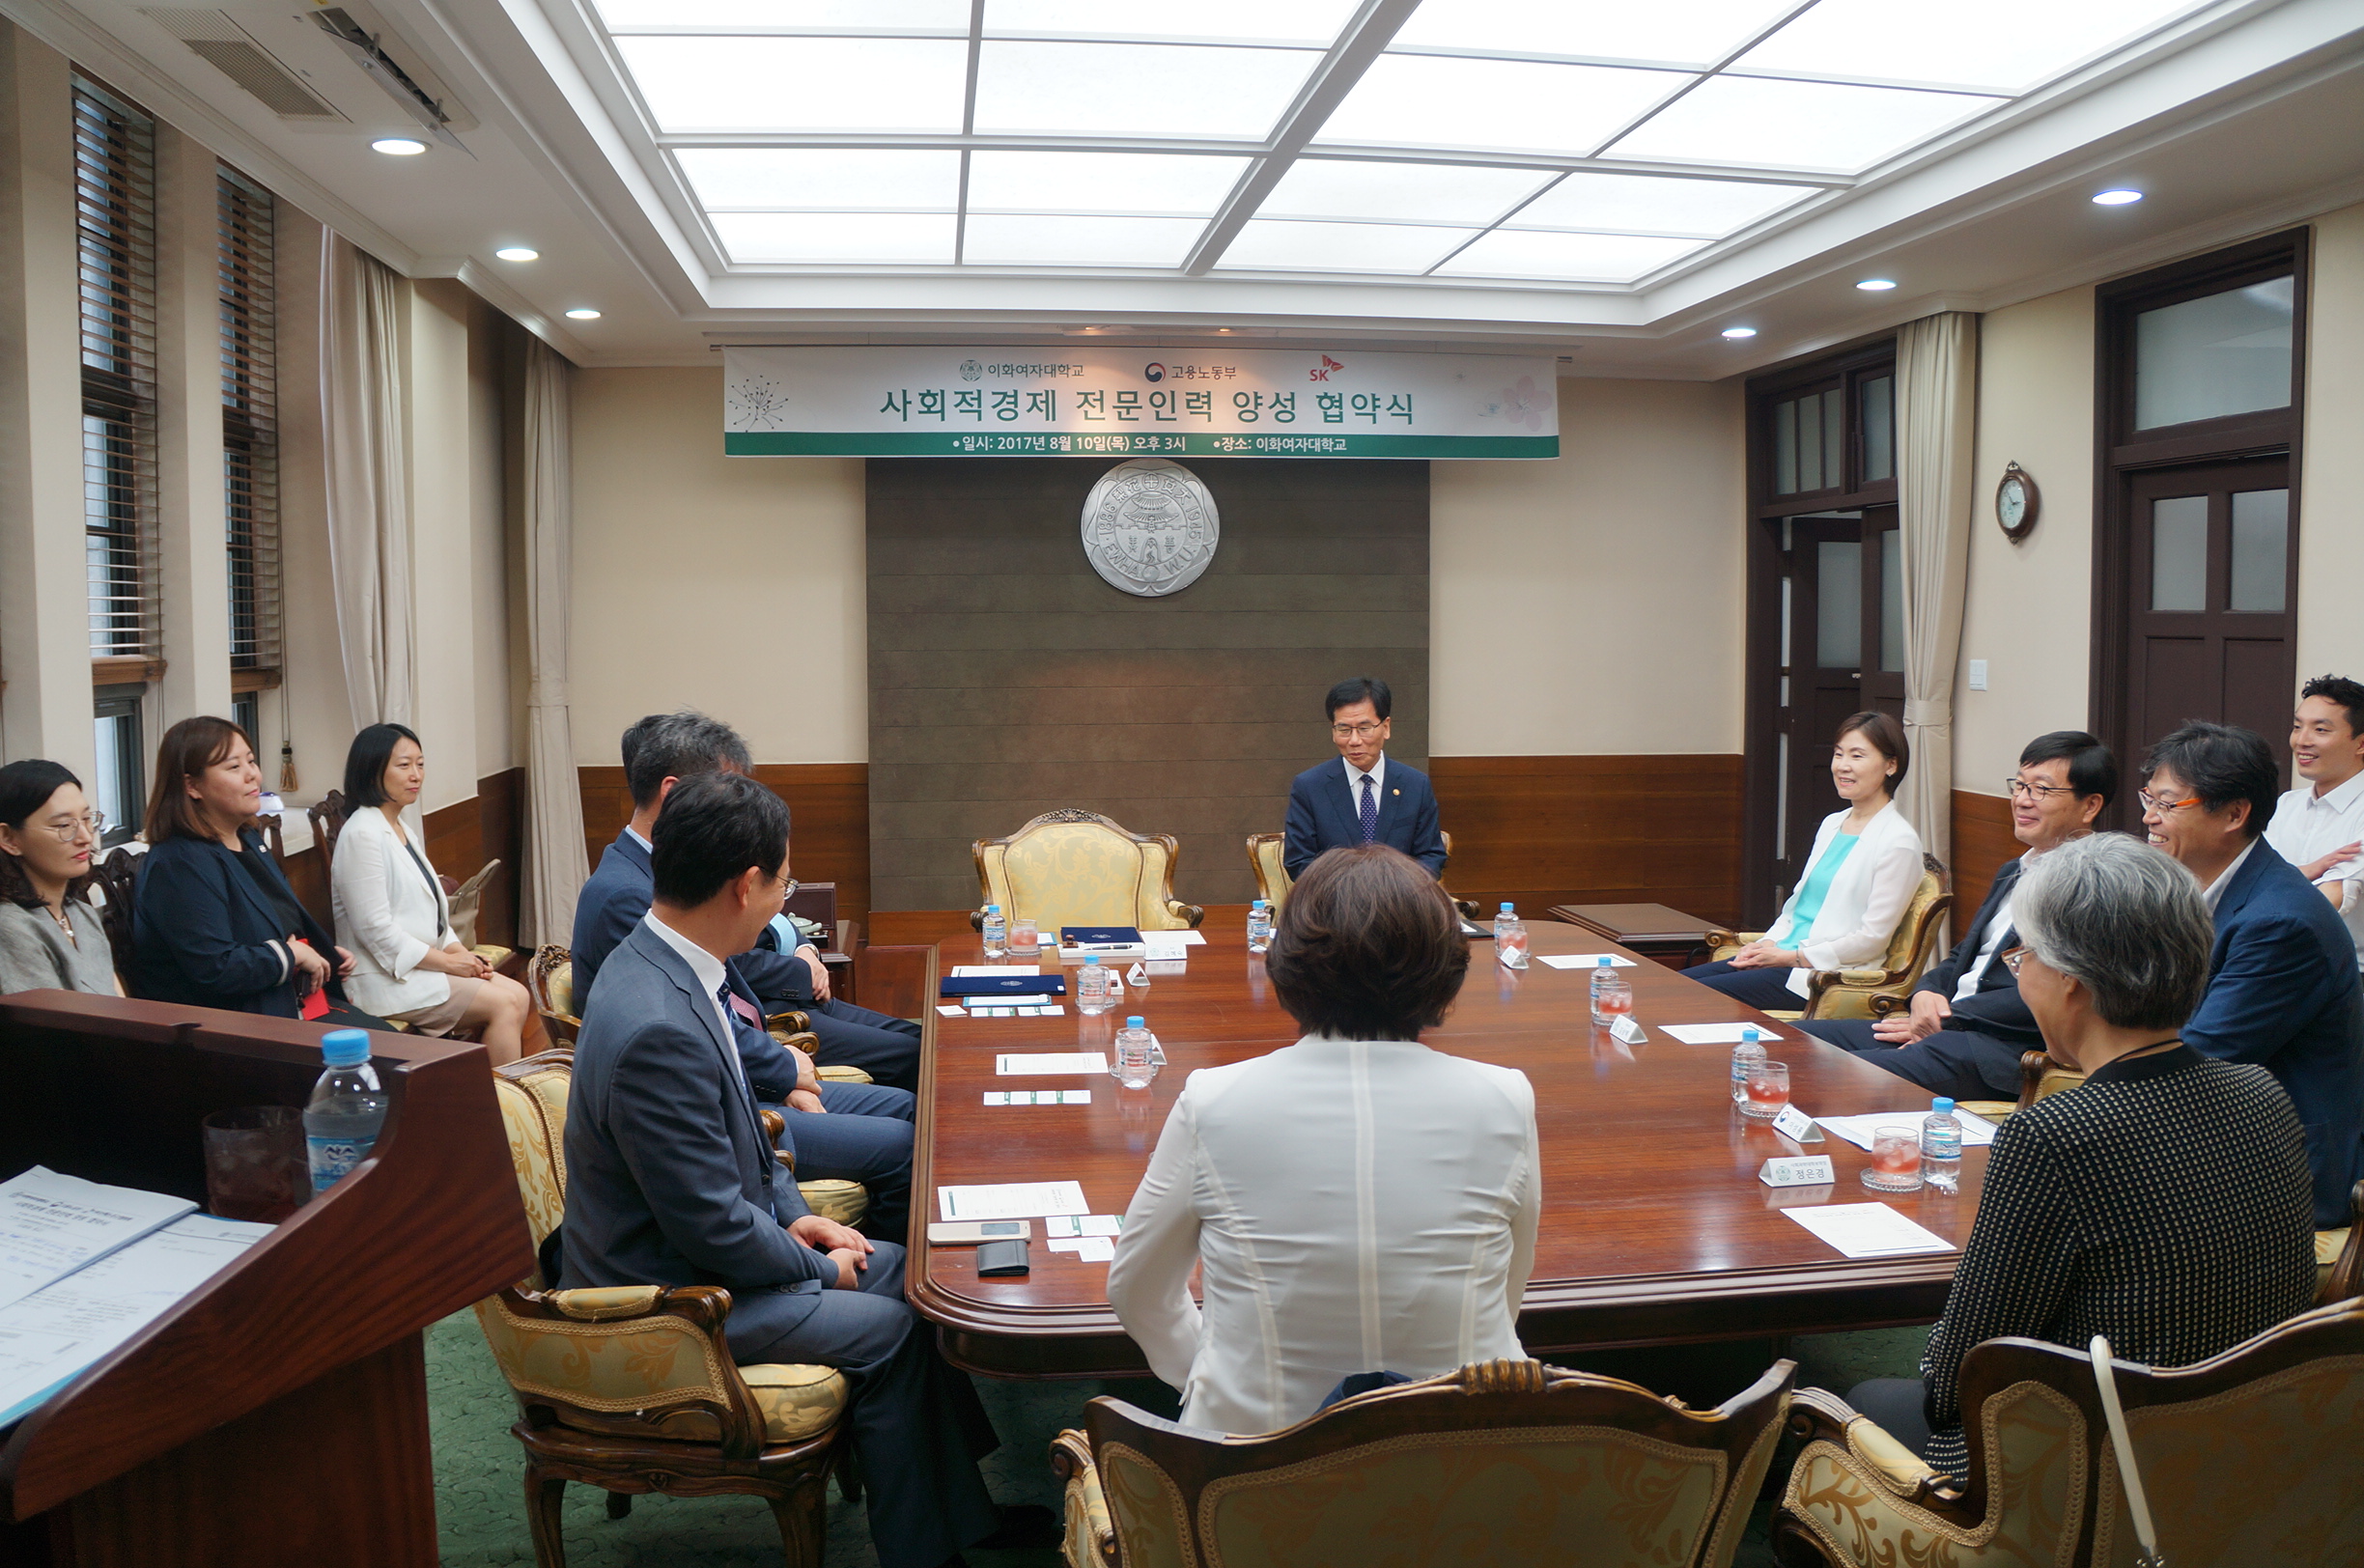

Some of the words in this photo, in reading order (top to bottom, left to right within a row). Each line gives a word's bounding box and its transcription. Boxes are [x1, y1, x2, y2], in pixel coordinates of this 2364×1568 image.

[988, 363, 1084, 378] 이화여자대학교
[1171, 366, 1237, 380] 고용노동부
[1309, 369, 1329, 381] SK
[880, 388, 1056, 422] 사회적경제
[1076, 389, 1213, 423] 전문인력
[1232, 390, 1297, 423] 양성
[1316, 391, 1415, 425] 협약식
[963, 436, 994, 451] 일시:
[998, 436, 1046, 451] 2017년
[1050, 436, 1072, 451] 8월
[1076, 436, 1130, 452] 10일(목)
[1134, 436, 1161, 451] 오후
[1165, 436, 1187, 452] 3시
[1222, 437, 1252, 452] 장소:
[1255, 437, 1348, 453] 이화여자대학교
[1098, 502, 1117, 536] 1886
[1186, 506, 1202, 540] 1945
[1104, 543, 1140, 578] EWHA
[1795, 1168, 1825, 1180] 정은경
